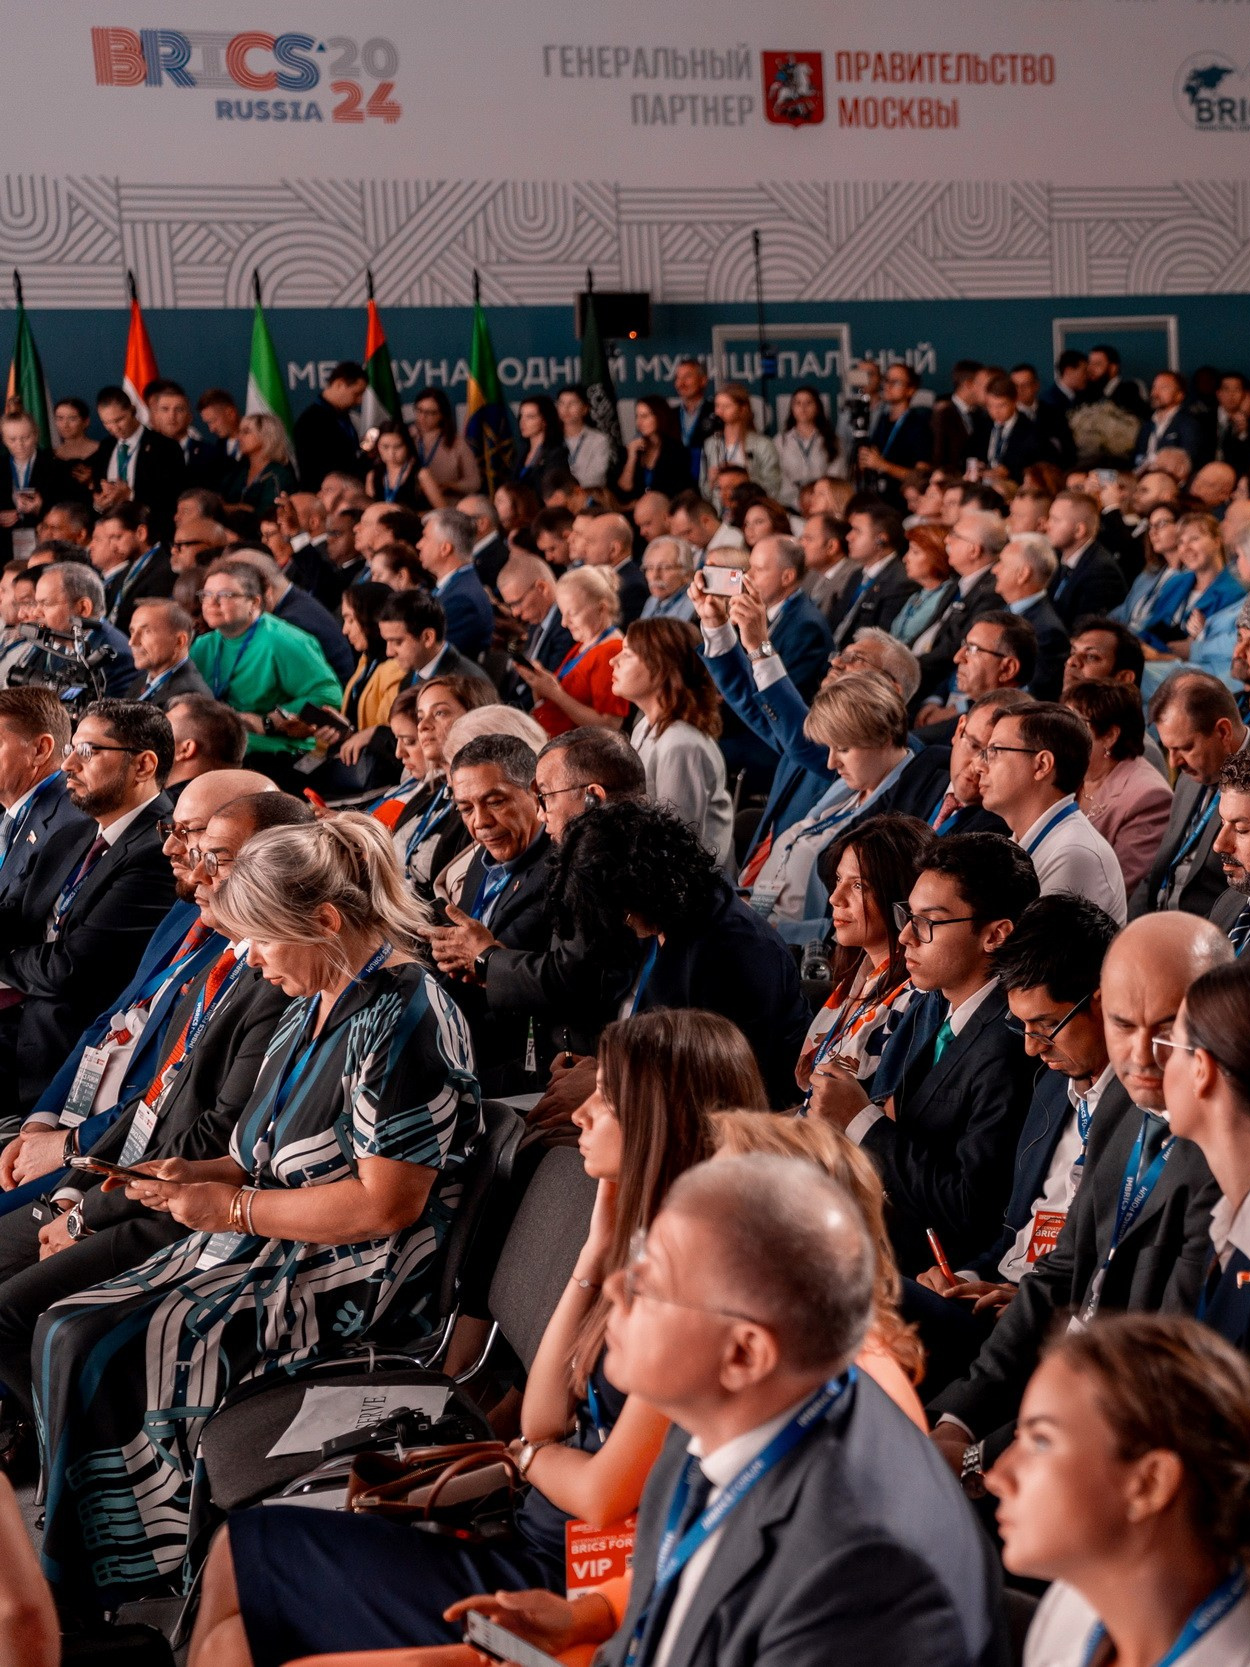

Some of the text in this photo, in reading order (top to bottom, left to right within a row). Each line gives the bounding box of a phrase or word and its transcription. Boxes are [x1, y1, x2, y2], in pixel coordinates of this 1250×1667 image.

[91, 26, 400, 92] BRICS 20
[542, 42, 751, 81] ГЕНЕРАЛЬНЫЙ
[834, 51, 1056, 86] ПРАВИТЕЛЬСТВО
[215, 80, 403, 124] RUSSIA 24
[630, 92, 754, 127] ПАРТНЕР
[837, 95, 961, 129] МОСКВЫ
[287, 346, 628, 390] МЕУНАОДНЙ
[1121, 1176, 1134, 1211] IMBRICS
[1129, 1186, 1148, 1213] FORUM
[571, 1538, 634, 1555] BRICS FOR
[571, 1557, 613, 1580] VIP
